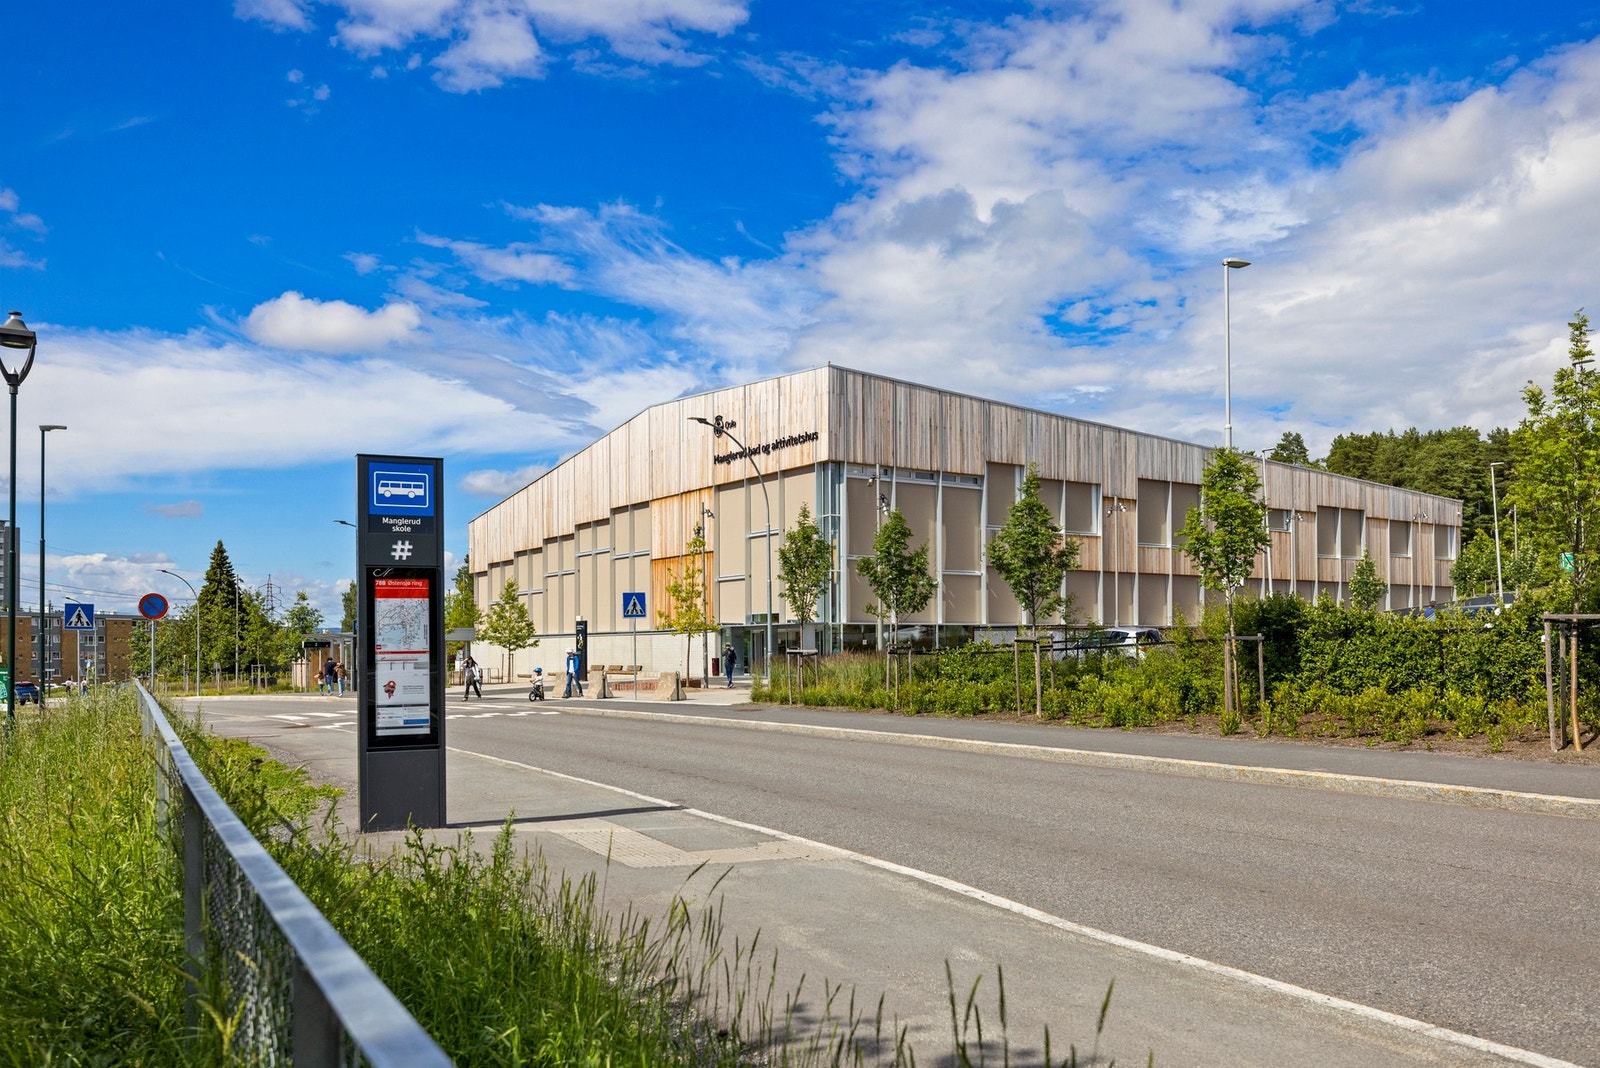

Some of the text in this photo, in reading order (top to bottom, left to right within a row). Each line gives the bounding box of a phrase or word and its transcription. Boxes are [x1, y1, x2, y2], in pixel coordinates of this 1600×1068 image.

[725, 420, 737, 430] Oslo
[748, 443, 760, 457] bad
[762, 443, 771, 456] og
[772, 431, 819, 451] aktivitetshus
[382, 517, 421, 526] Manglerud
